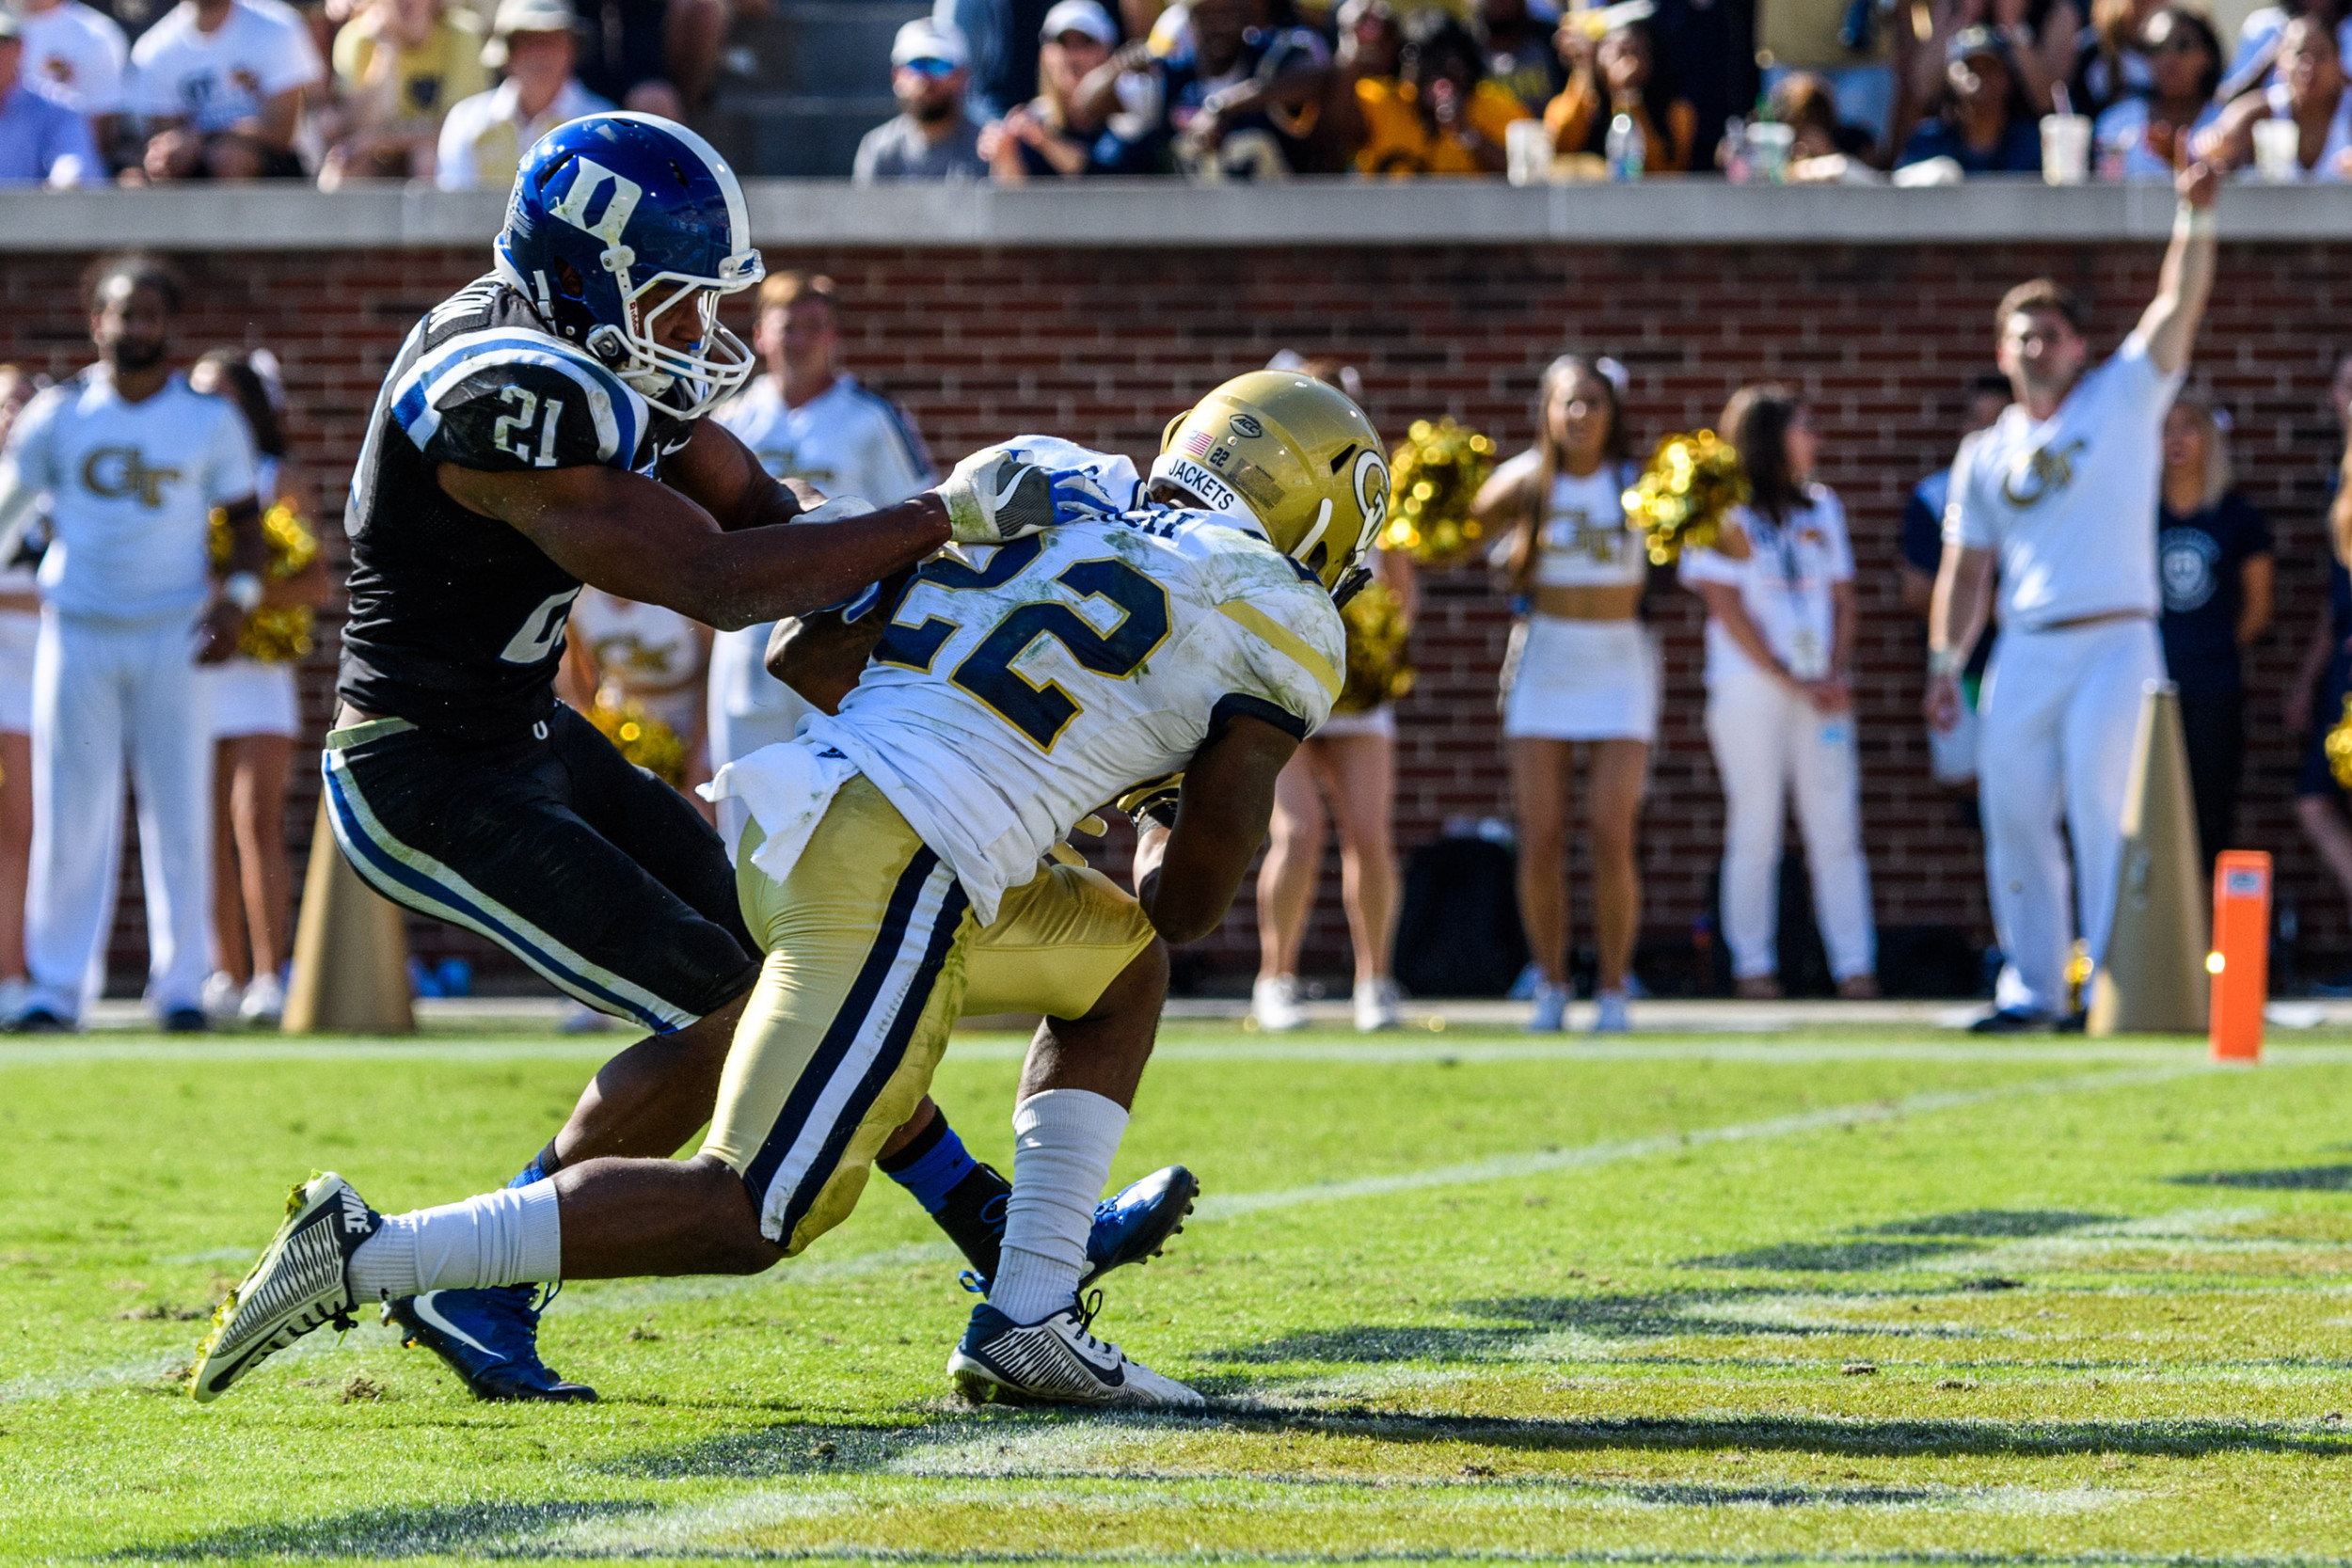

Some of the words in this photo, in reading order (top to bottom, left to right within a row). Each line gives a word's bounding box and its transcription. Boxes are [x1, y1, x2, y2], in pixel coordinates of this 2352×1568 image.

[494, 385, 564, 467] 21
[83, 446, 182, 507] GT
[1168, 458, 1235, 511] JACKETS
[1209, 446, 1231, 468] 22
[871, 531, 1172, 756] 22
